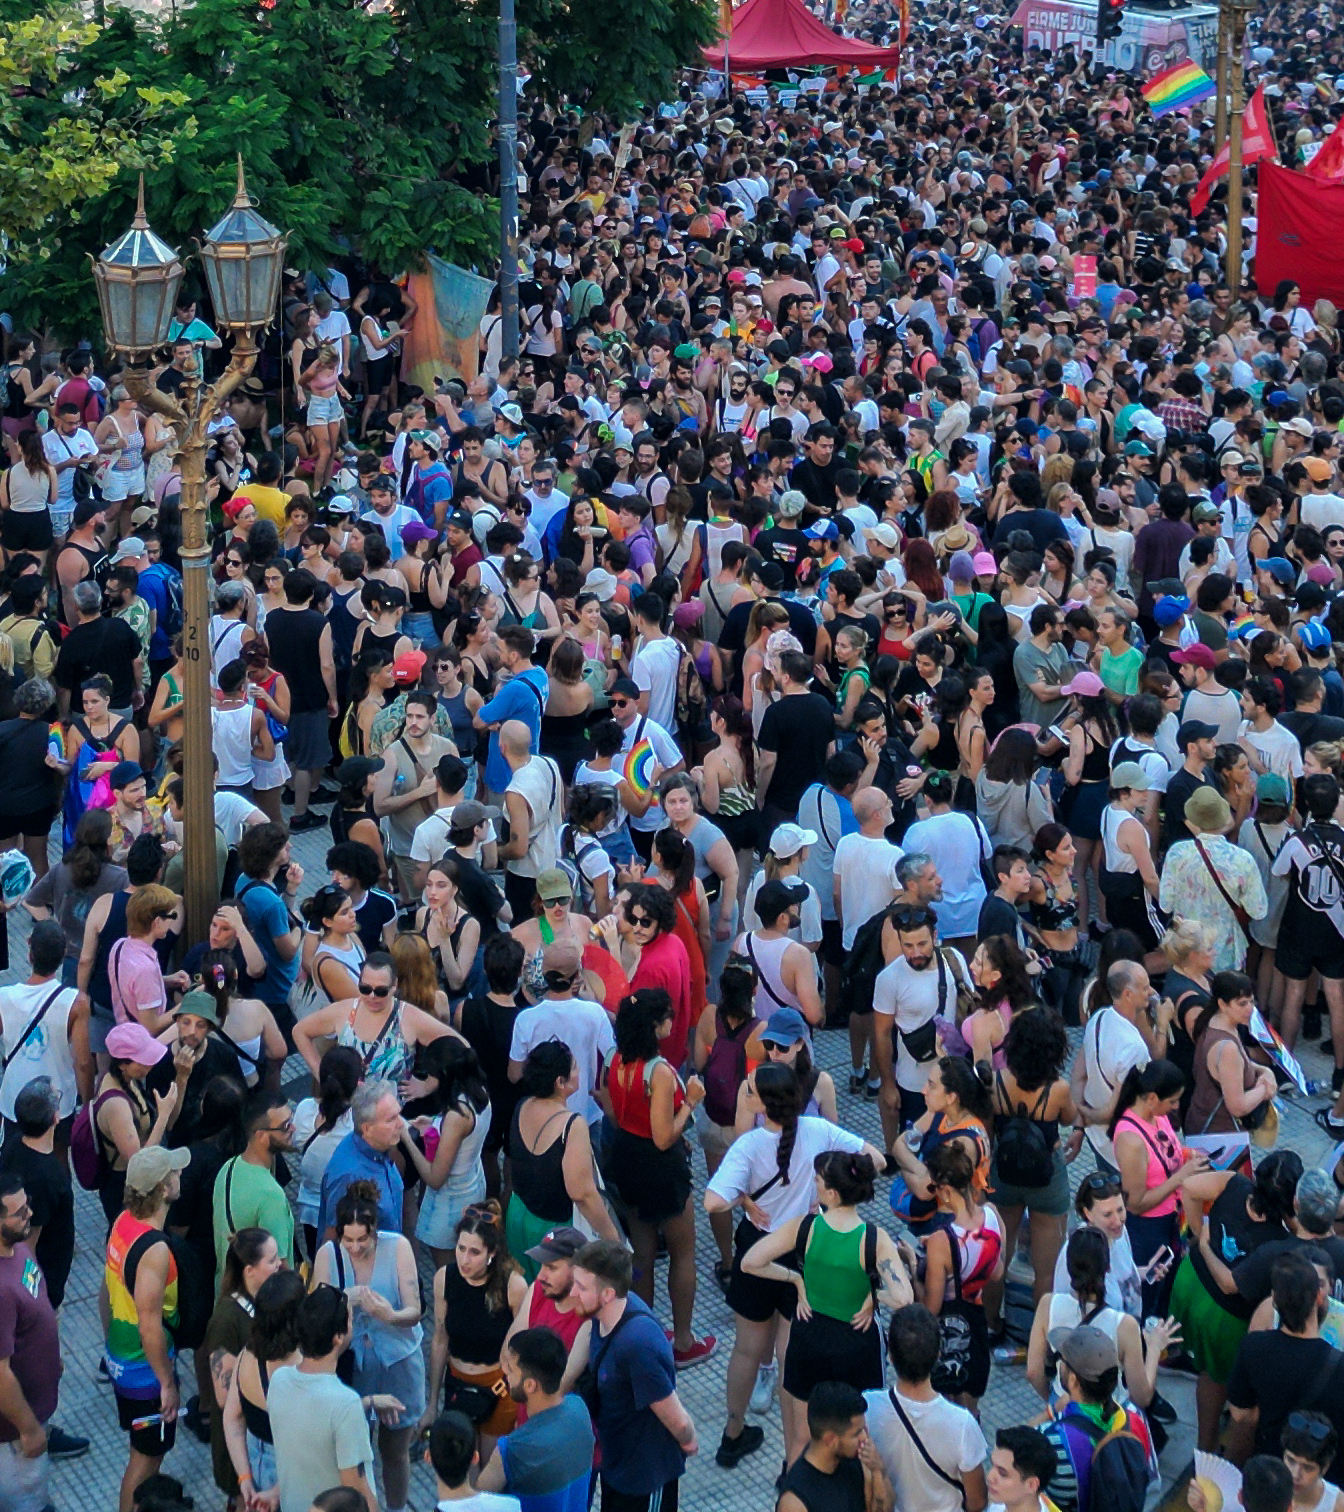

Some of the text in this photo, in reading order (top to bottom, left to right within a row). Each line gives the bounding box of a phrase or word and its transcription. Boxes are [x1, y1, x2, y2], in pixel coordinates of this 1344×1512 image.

[1027, 11, 1068, 30] FIRME
[189, 626, 196, 640] 2
[186, 647, 200, 661] 10
[1308, 865, 1341, 905] 10
